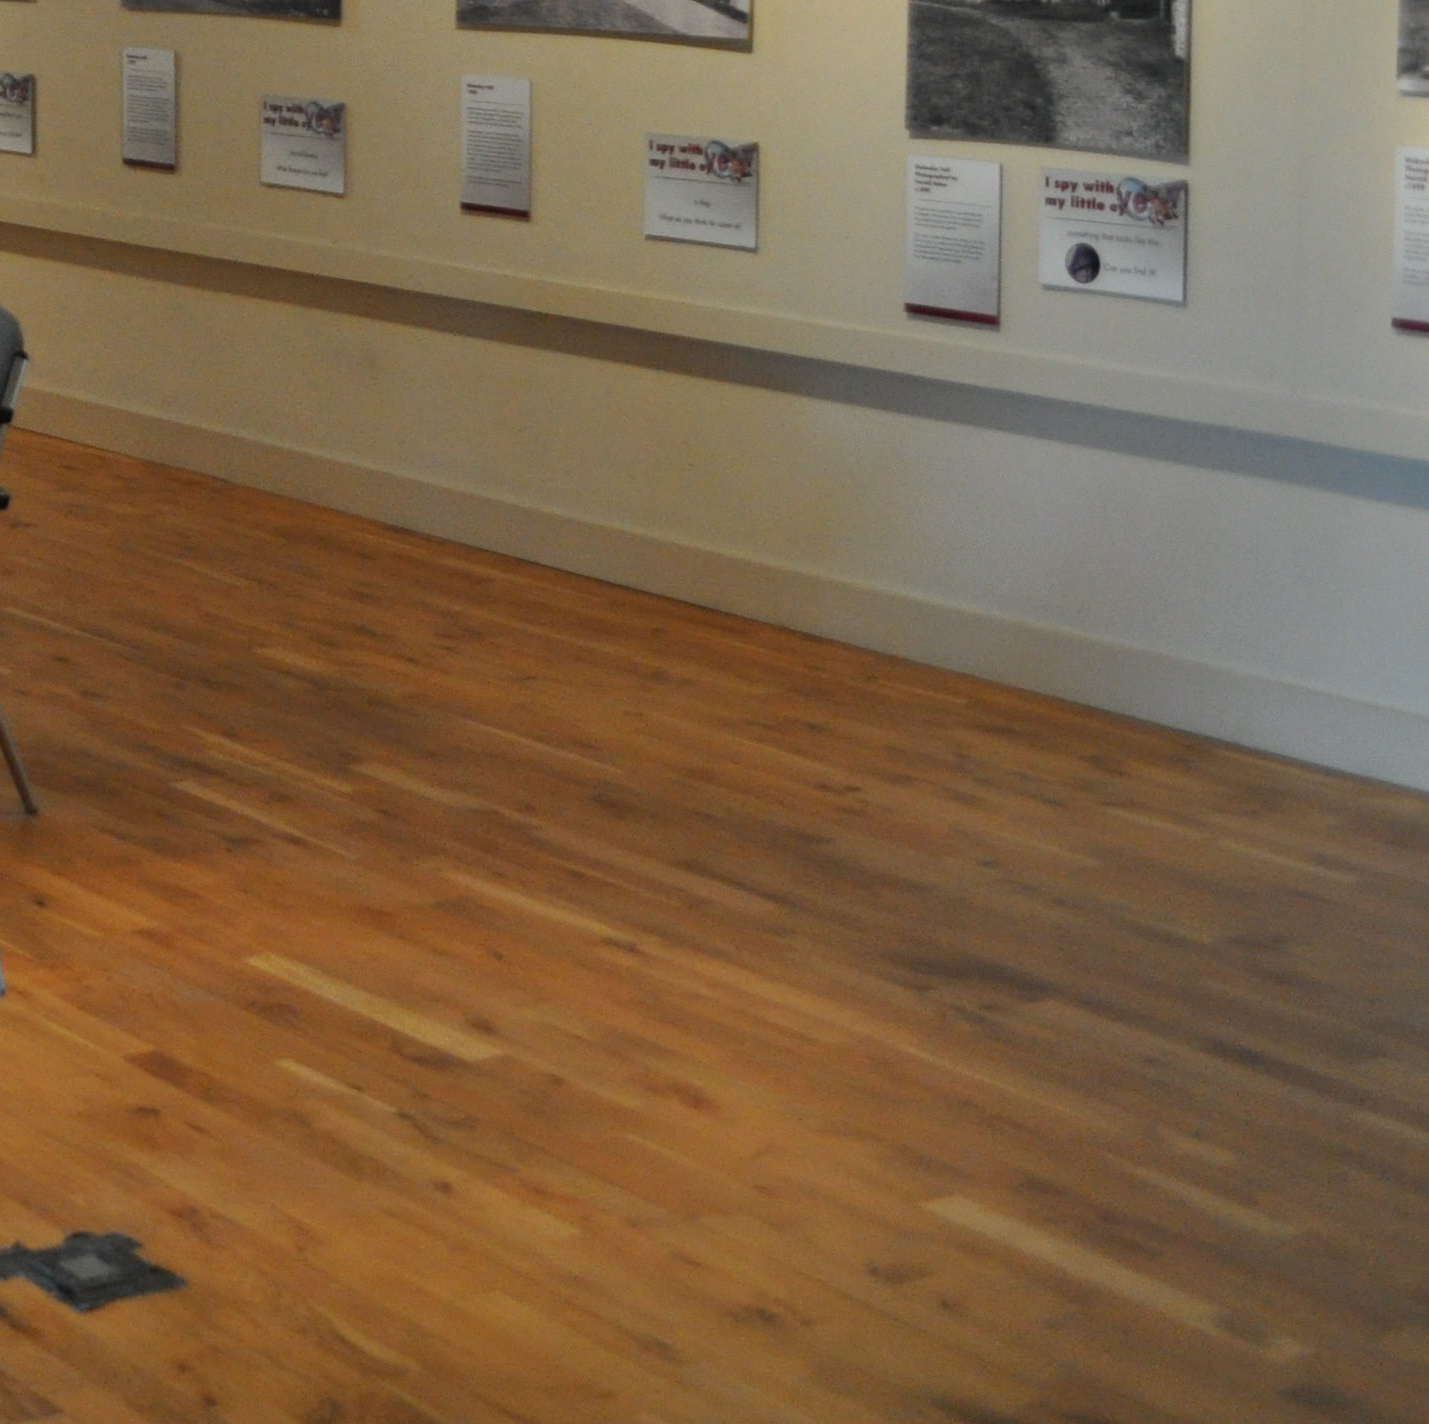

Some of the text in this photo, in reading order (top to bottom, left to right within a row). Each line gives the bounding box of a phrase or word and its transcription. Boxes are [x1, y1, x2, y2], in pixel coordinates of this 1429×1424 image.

[1044, 176, 1115, 194] I spy with
[1044, 196, 1065, 210] my
[1070, 195, 1106, 211] little
